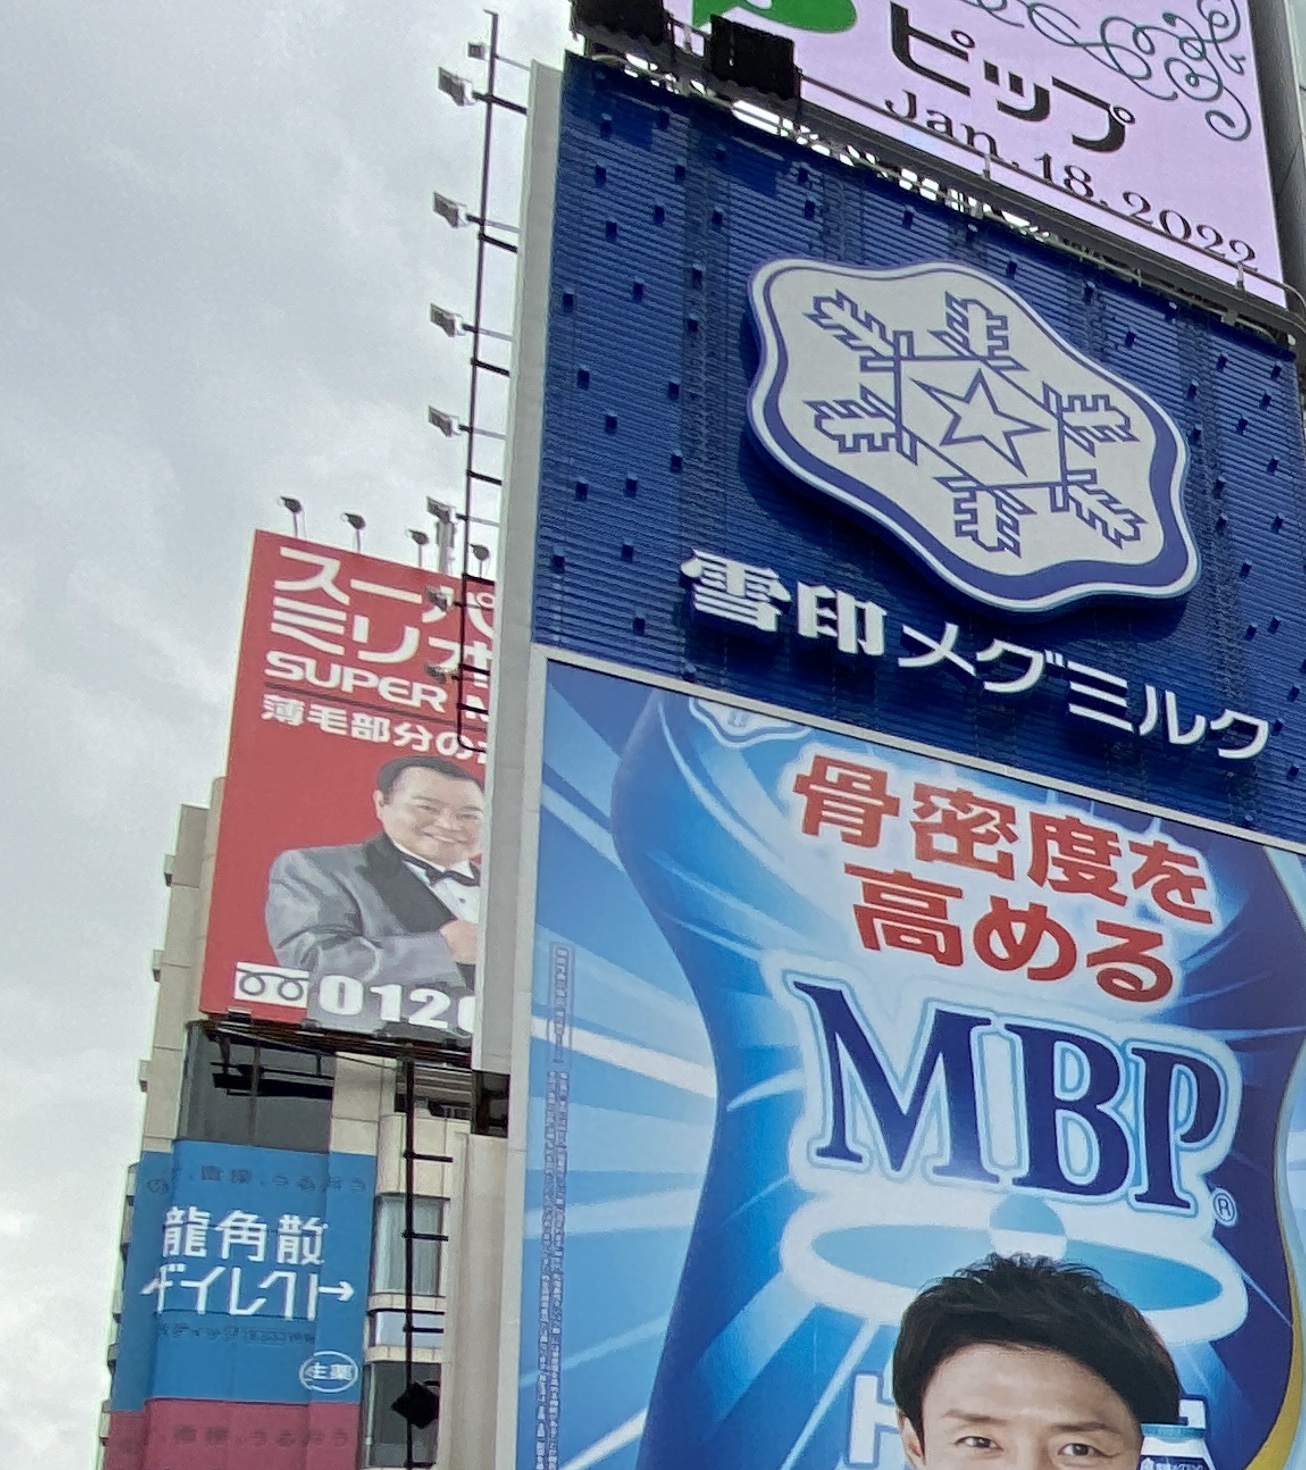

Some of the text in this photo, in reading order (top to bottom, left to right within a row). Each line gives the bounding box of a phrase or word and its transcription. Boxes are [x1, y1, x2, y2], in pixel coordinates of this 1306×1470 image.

[890, 2, 1136, 153] ピップ
[261, 693, 488, 765] 薄毛部分の
[264, 650, 448, 714] SUPER
[681, 550, 1270, 762] 雪印メグミルク
[792, 754, 1213, 926] 骨密度を
[843, 861, 1174, 1004] 高める
[792, 979, 1222, 1215] MBP
[162, 1205, 329, 1265] 龍角散
